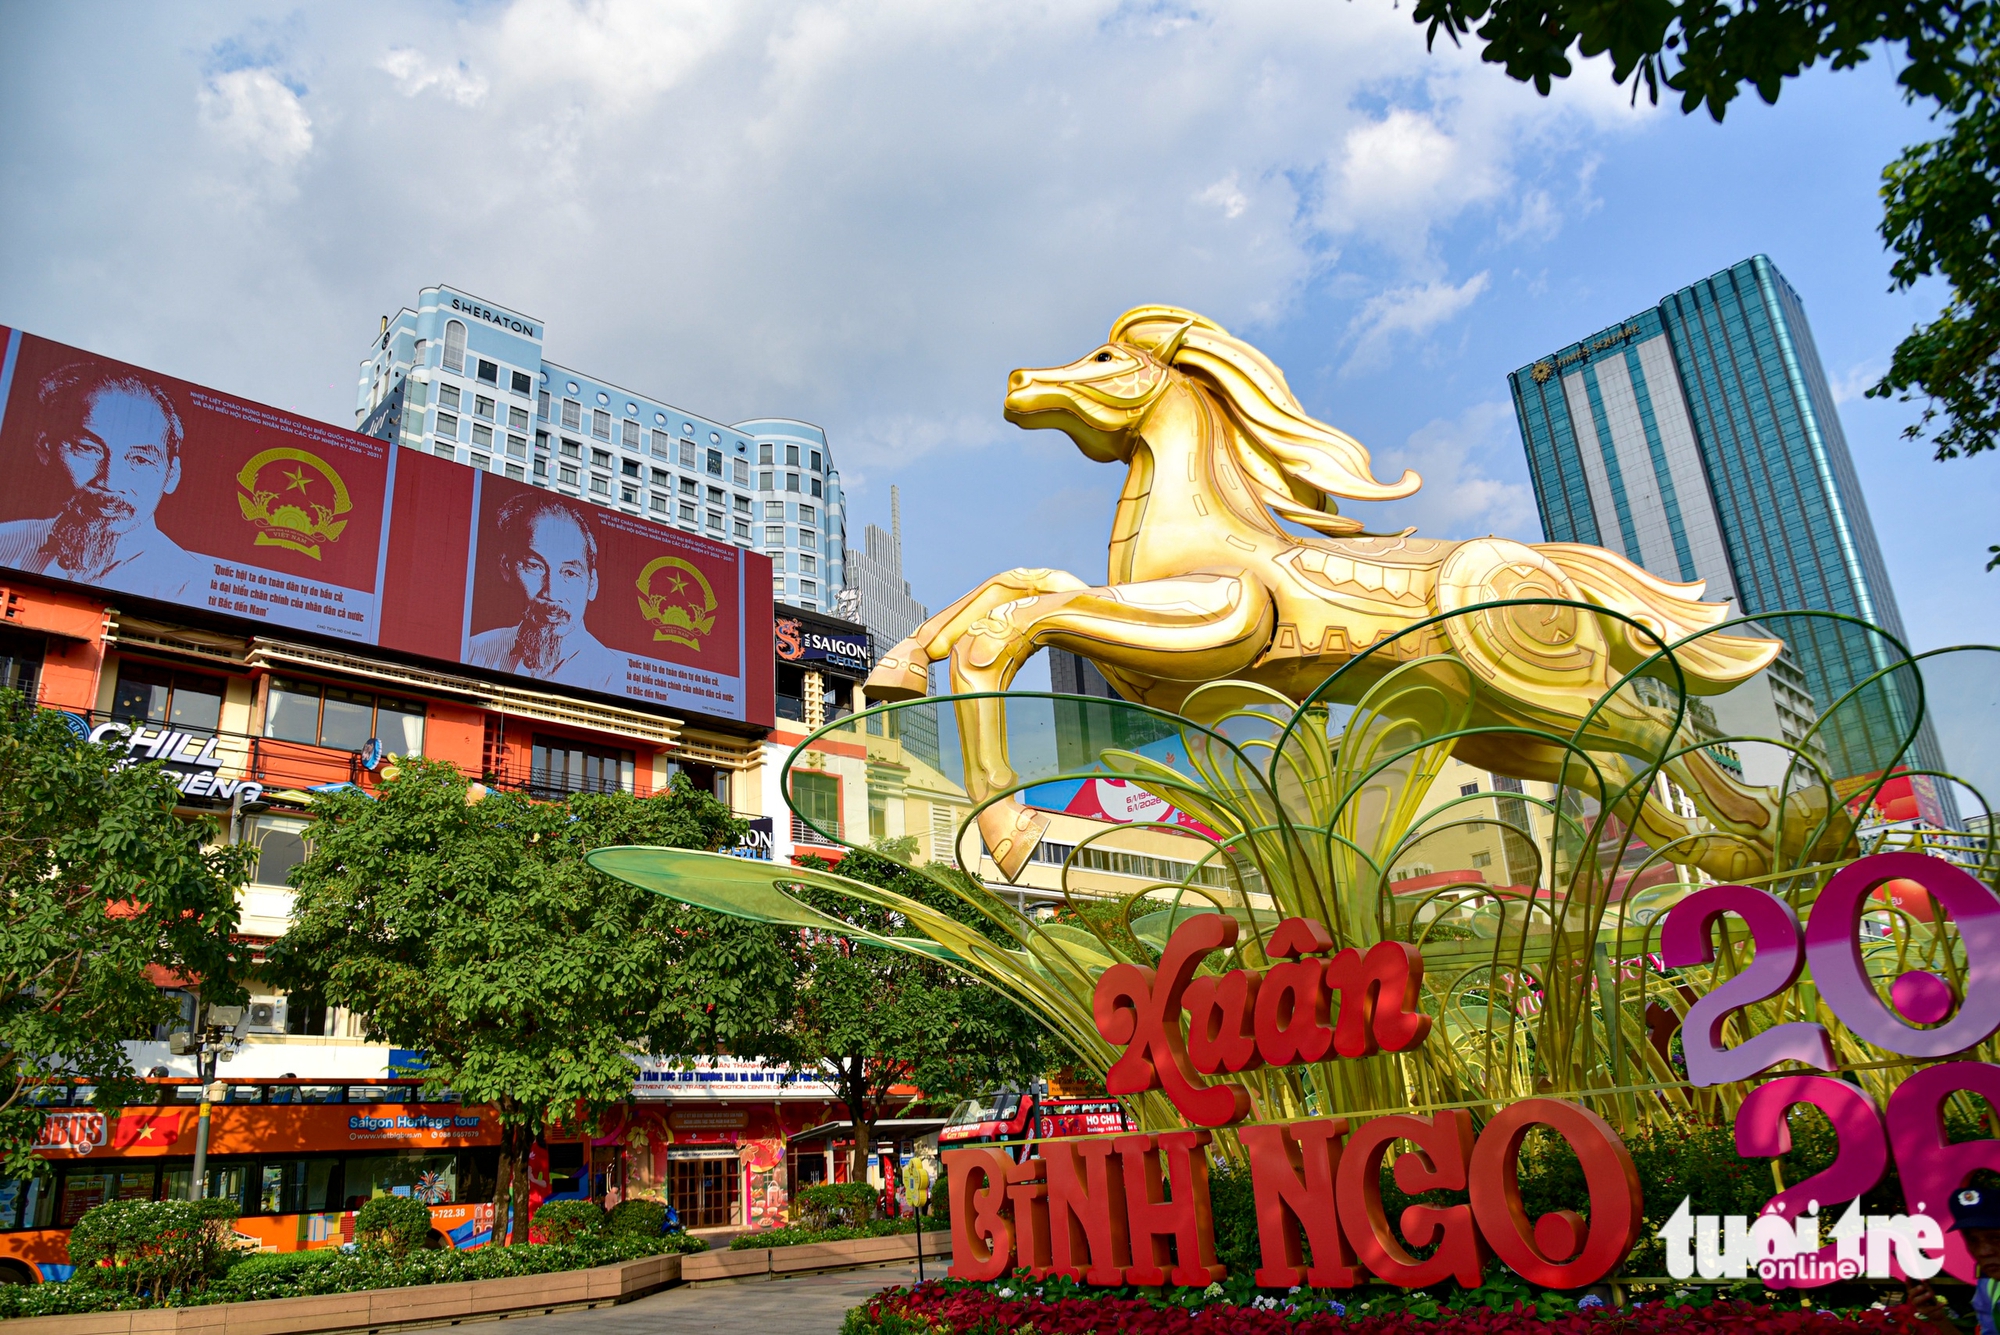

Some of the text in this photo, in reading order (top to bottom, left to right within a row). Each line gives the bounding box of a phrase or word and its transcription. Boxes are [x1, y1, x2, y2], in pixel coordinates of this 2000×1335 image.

[452, 298, 534, 337] SHERATON
[1556, 324, 1641, 368] TIMES SQUARE
[236, 569, 247, 582] hội
[249, 573, 256, 582] ta
[258, 575, 267, 585] do
[269, 577, 284, 589] toàn
[286, 581, 299, 592] dân
[301, 585, 309, 596] tự
[310, 587, 318, 596] do
[320, 589, 332, 600] bầu
[210, 579, 364, 622] là đại biểu chân chính của nhân dân cả nước
[218, 597, 232, 609] Bắc
[234, 601, 248, 612] đến
[812, 635, 867, 659] SAIGON
[88, 722, 224, 768] CHILL
[1126, 792, 1154, 804] 6/1/194
[1661, 851, 2000, 1087] 20
[1092, 913, 1432, 1127] Xuân
[350, 1115, 479, 1130] Saigon Heritage tour
[1086, 1115, 1099, 1125] HO
[1100, 1115, 1115, 1124] CHI
[357, 1132, 422, 1140] www.vietbigbus.vn
